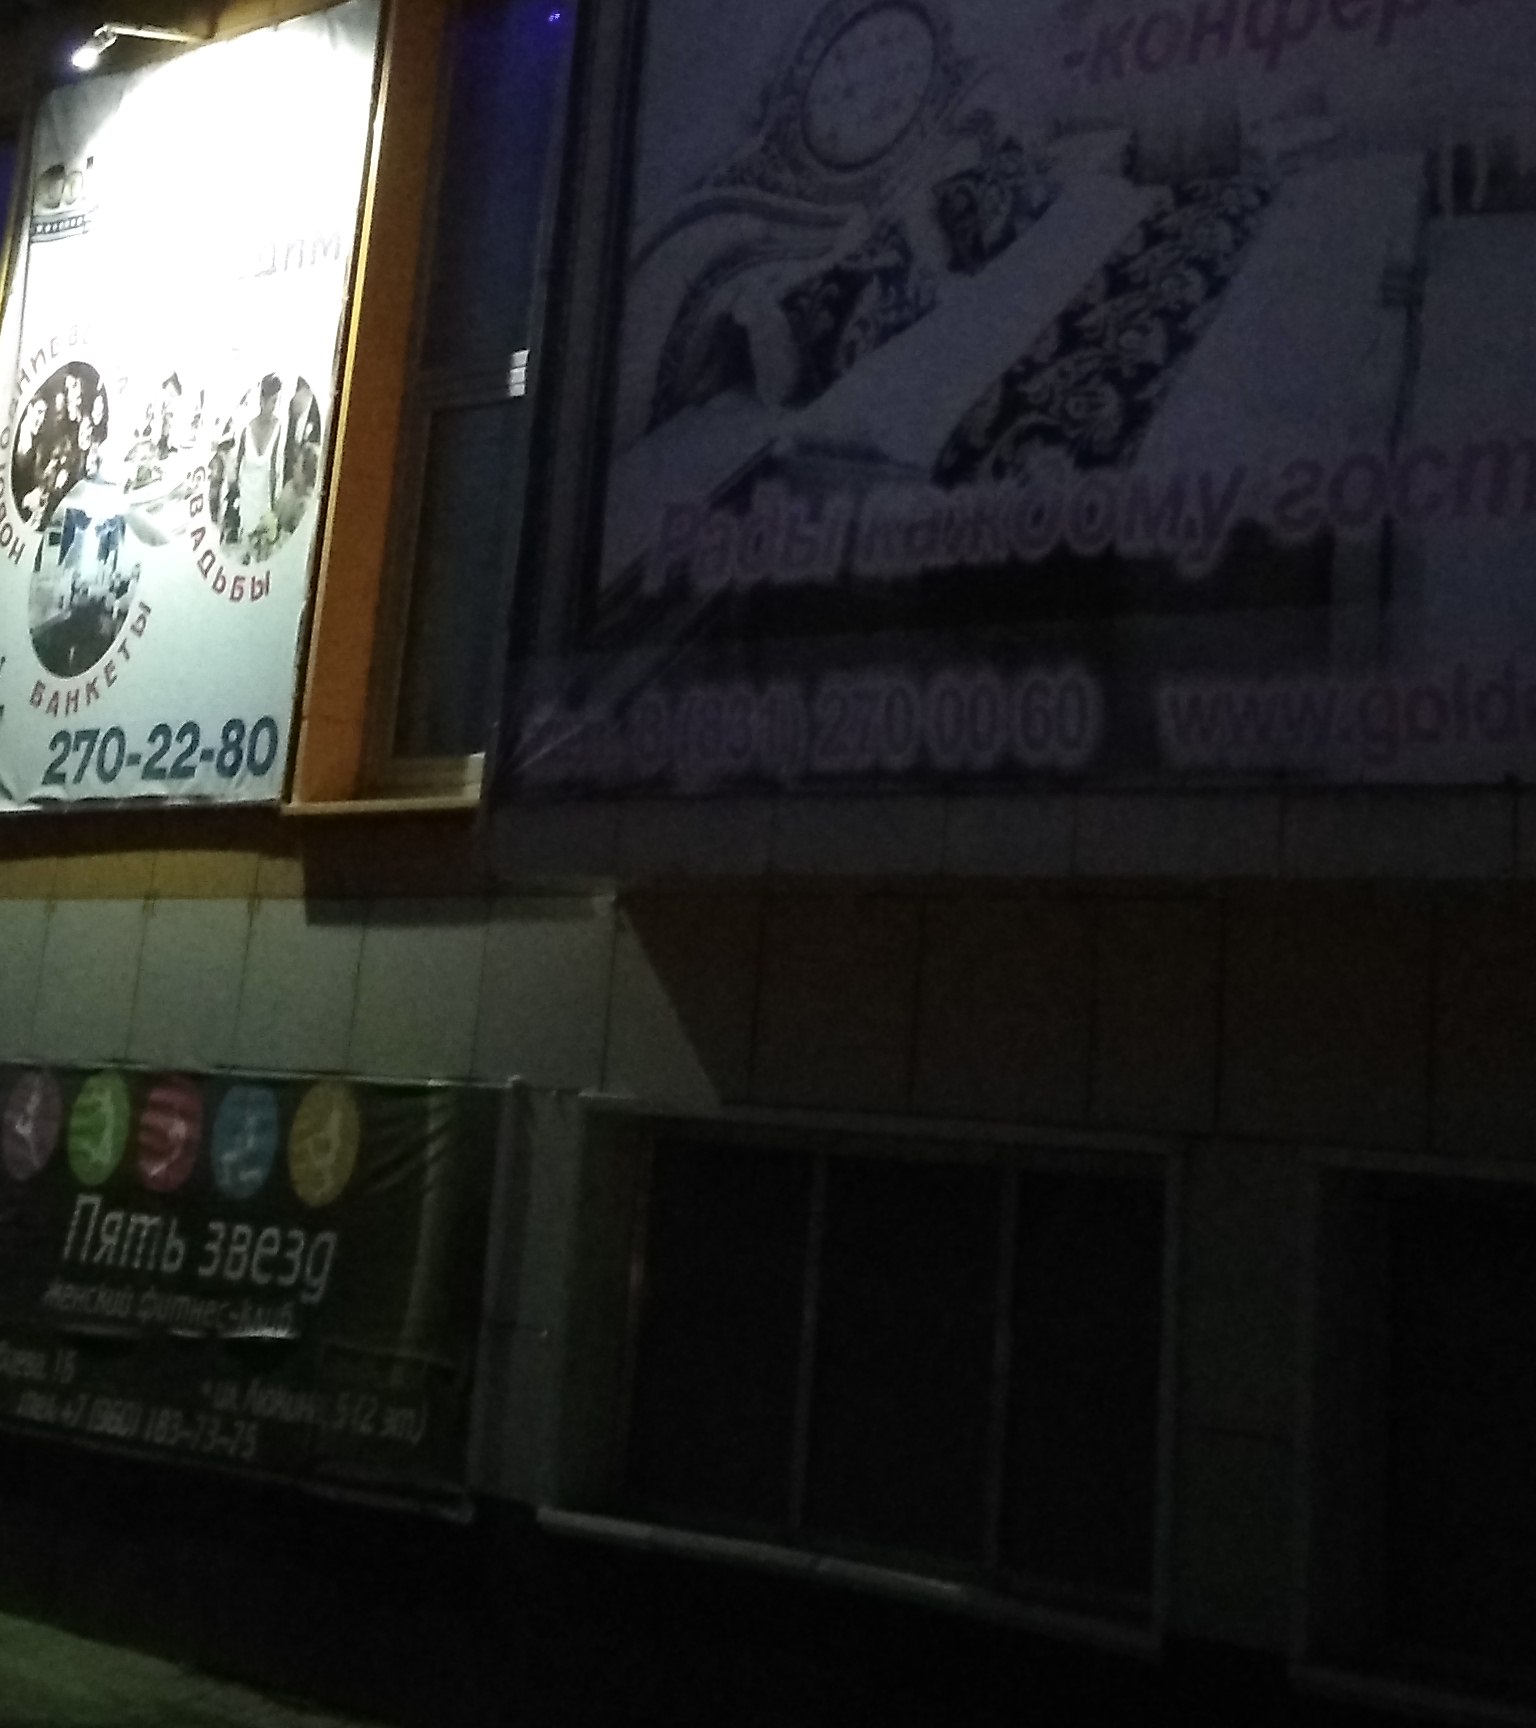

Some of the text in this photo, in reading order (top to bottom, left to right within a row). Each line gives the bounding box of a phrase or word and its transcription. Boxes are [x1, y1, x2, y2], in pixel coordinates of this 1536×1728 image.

[29, 601, 152, 718] БАНКЕТЫ
[41, 715, 279, 786] 270-22-80
[63, 1194, 338, 1304] Пять звезд
